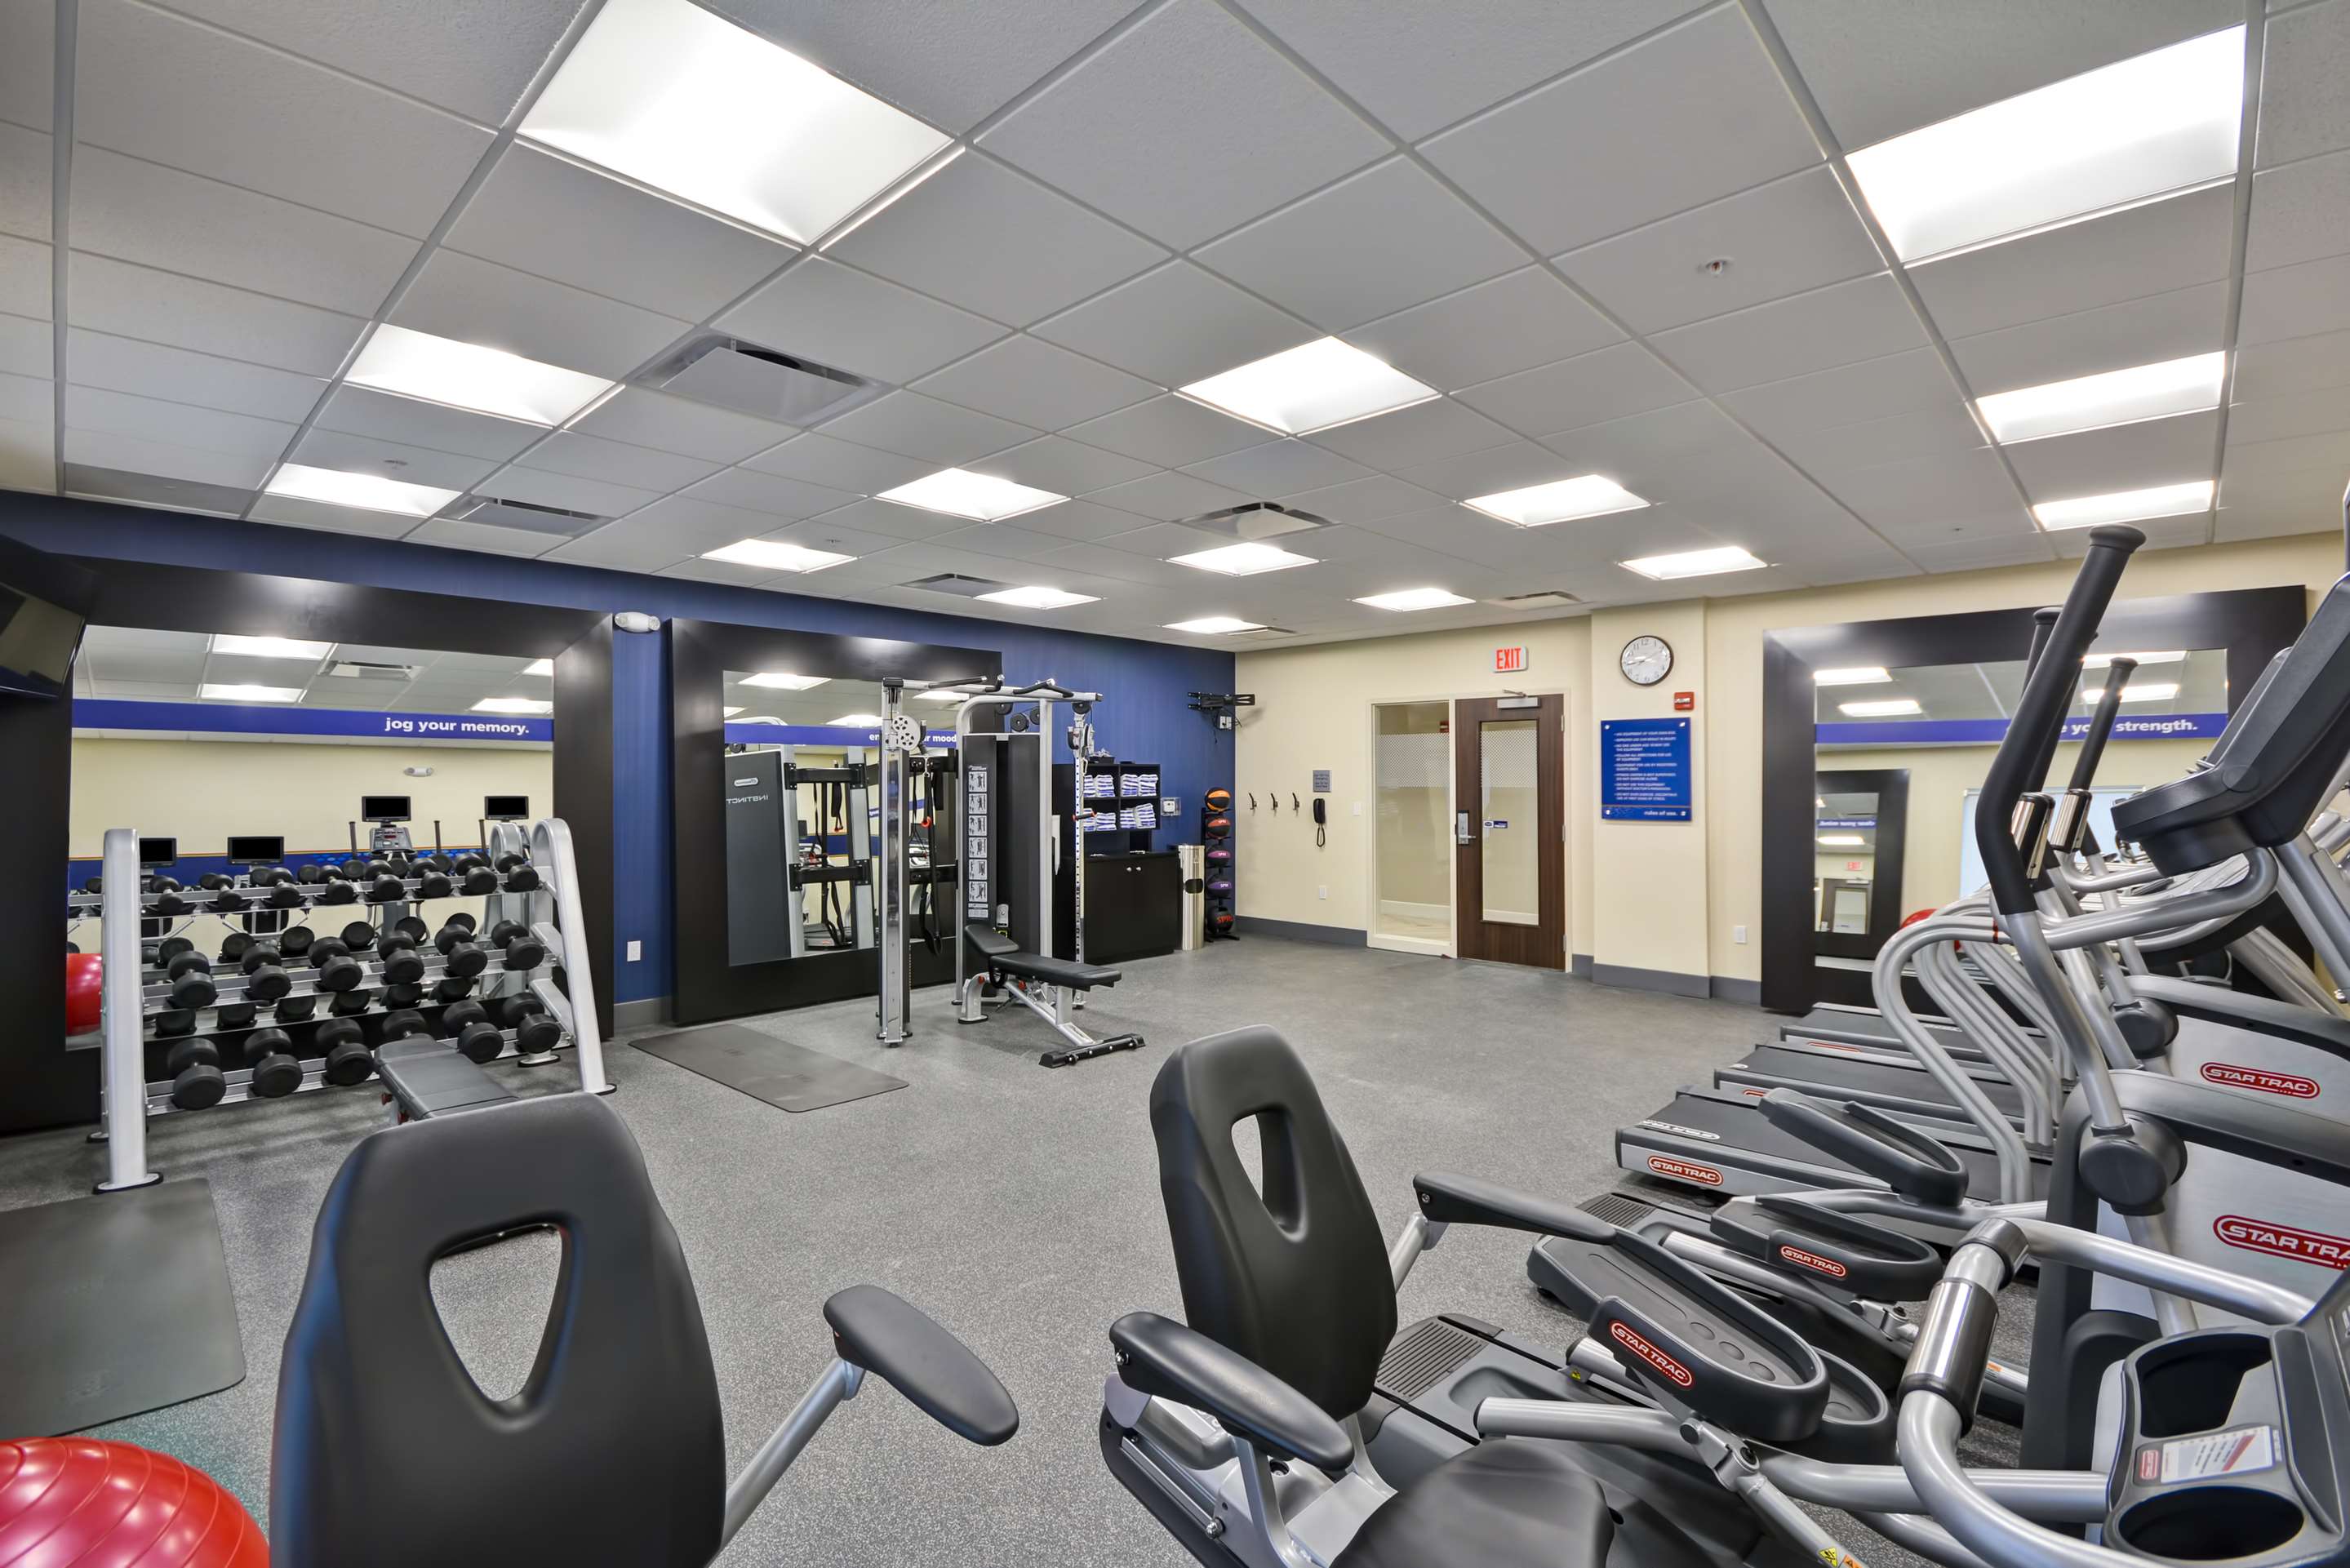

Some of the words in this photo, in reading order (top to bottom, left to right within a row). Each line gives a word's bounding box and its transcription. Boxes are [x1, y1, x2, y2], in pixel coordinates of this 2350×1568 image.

[1496, 647, 1522, 669] EXIT
[384, 717, 413, 732] jog
[418, 721, 457, 732] your
[460, 722, 530, 735] memory.
[2115, 719, 2198, 734] strength.
[2210, 1068, 2255, 1083] STAR
[2258, 1077, 2309, 1091] TRAC
[1652, 1161, 1682, 1174] STAR
[1684, 1167, 1717, 1181] TRAC
[2228, 1225, 2299, 1250] STAR
[1785, 1249, 1811, 1263] STAR
[1812, 1258, 1841, 1273] TRAC
[1616, 1328, 1649, 1354] STAR
[1650, 1351, 1686, 1379] TRAC
